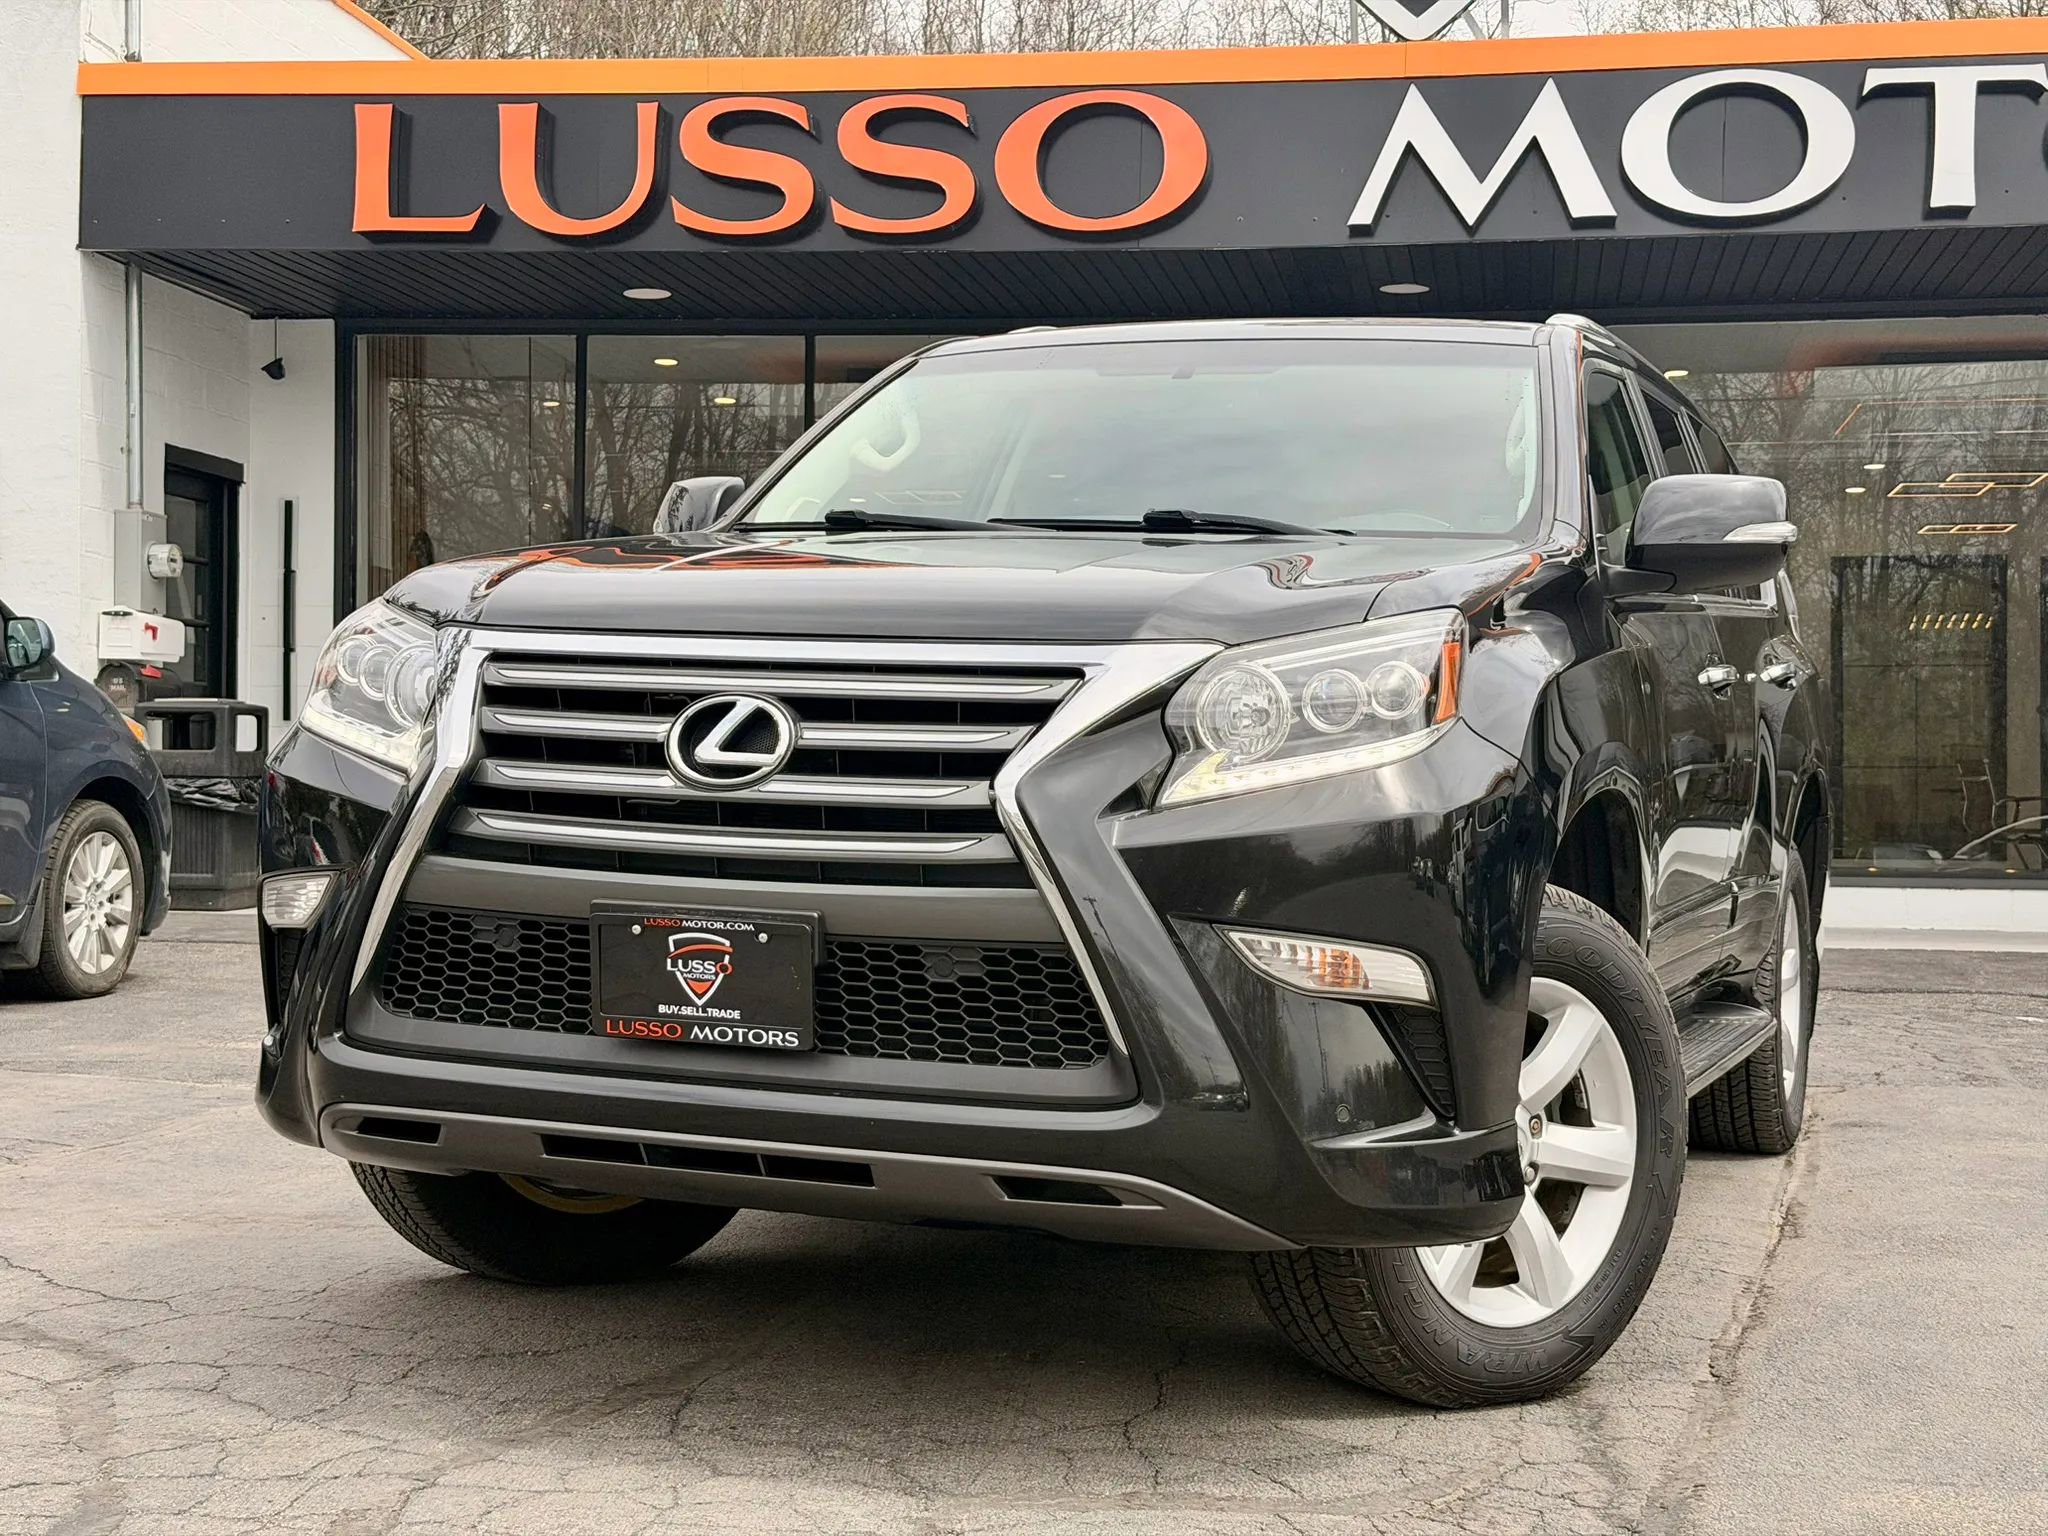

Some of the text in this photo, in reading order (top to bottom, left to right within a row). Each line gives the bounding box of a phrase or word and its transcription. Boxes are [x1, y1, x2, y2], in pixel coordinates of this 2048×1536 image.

[353, 63, 2048, 235] LUSSO MOT
[666, 957, 733, 975] LUSSO
[682, 972, 716, 981] MOTORS
[658, 1004, 741, 1020] BUY.SELL.TRADE
[606, 1019, 799, 1047] LUSSO MOTORS
